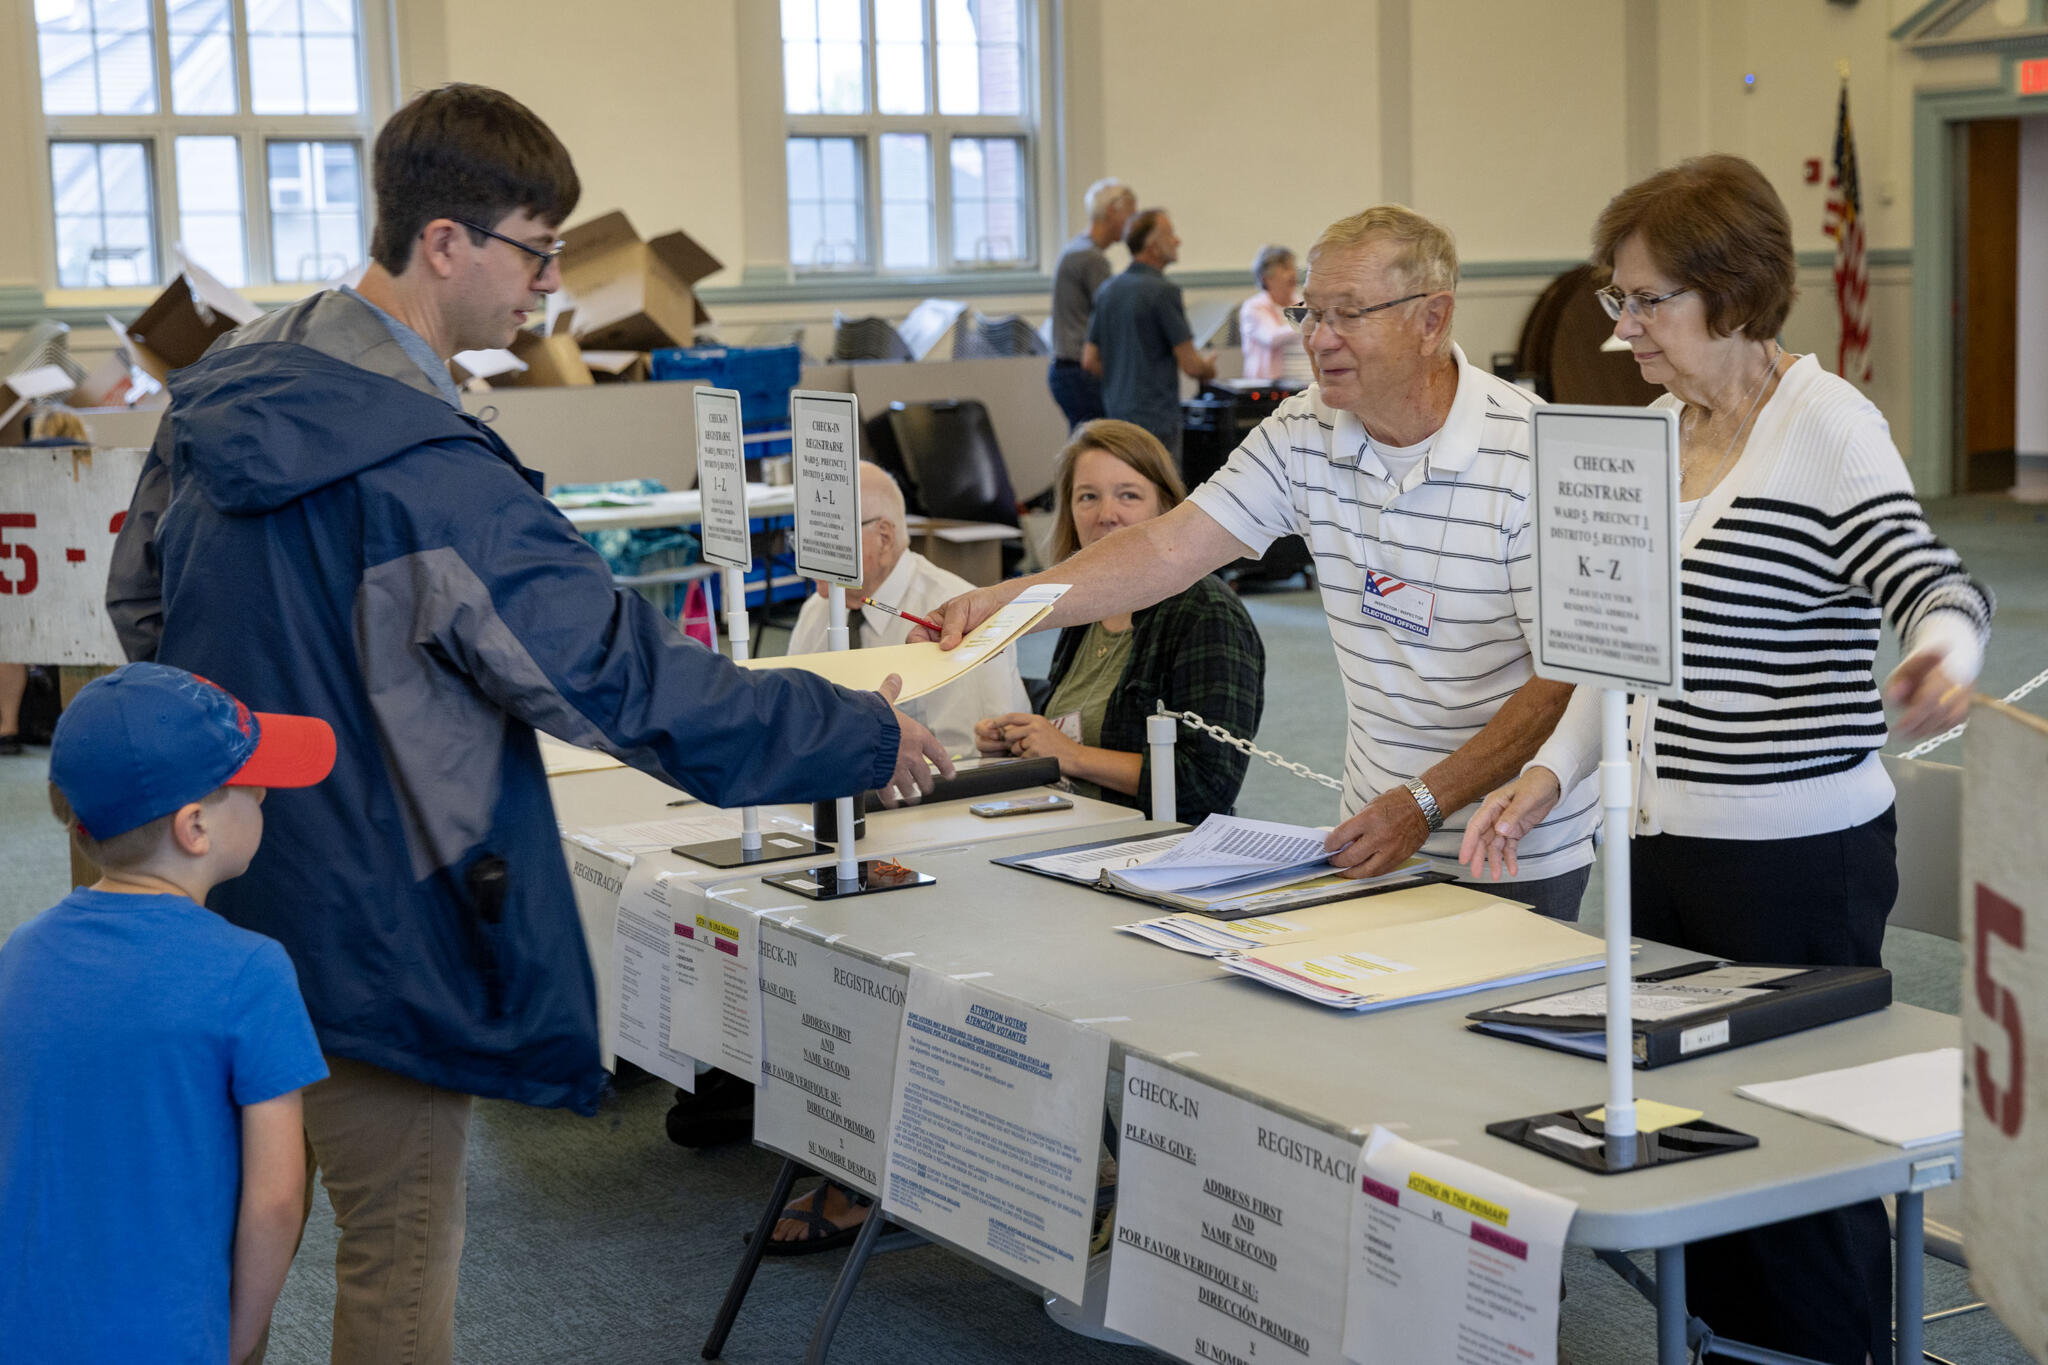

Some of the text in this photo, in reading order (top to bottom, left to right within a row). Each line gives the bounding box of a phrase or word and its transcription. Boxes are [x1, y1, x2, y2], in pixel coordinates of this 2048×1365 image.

[812, 420, 840, 433] CHECK-IN
[806, 438, 844, 453] REGISTRARSE
[804, 455, 816, 465] WARD
[820, 458, 843, 468] PRECINCT
[1573, 455, 1636, 473] CHECK-IN
[1558, 480, 1643, 504] REGISTRARSE
[1553, 506, 1580, 520] WARD
[1592, 510, 1640, 527] PRECINCT
[1550, 526, 1592, 542] DISTRITO
[1602, 532, 1646, 549] RECINTO
[1362, 606, 1428, 635] ELECTION OFFICIAL
[759, 939, 798, 968] HECK-IN
[759, 977, 778, 996] LEASE
[834, 967, 907, 1008] REGISTRACIÓN
[970, 1003, 1028, 1032] ATTENTION VOTERS
[1974, 880, 2027, 1141] 5
[802, 1013, 852, 1043] ADDRESS FIRST
[996, 1024, 1028, 1046] VOTANTES
[820, 1037, 835, 1053] AND
[803, 1048, 850, 1079] NAME SECOND
[762, 1060, 772, 1074] OR
[773, 1063, 795, 1084] FAVOR
[795, 1074, 829, 1101] VERIFIQUE
[1128, 1076, 1200, 1120] CHECK-IN
[806, 1099, 876, 1143] DIRECCIÓN PRIMERO
[808, 1140, 816, 1154] SU
[818, 1145, 846, 1170] NOMBRE
[1125, 1122, 1197, 1165] PLEASE GIVE:
[1257, 1126, 1356, 1184] REGISTRACI
[1203, 1177, 1283, 1225] ADDRESS FIRST
[1409, 1175, 1440, 1198] VOTING
[1440, 1186, 1450, 1201] IN
[1470, 1198, 1509, 1222] PRIMARY
[1232, 1213, 1255, 1235] AND
[1201, 1221, 1278, 1271] NAME SECOND
[1118, 1226, 1259, 1303] POR FAVOR VERIFIQUE SU:
[1199, 1286, 1310, 1356] DIRECCIÓN PRIMERO
[1195, 1337, 1210, 1355] SU
